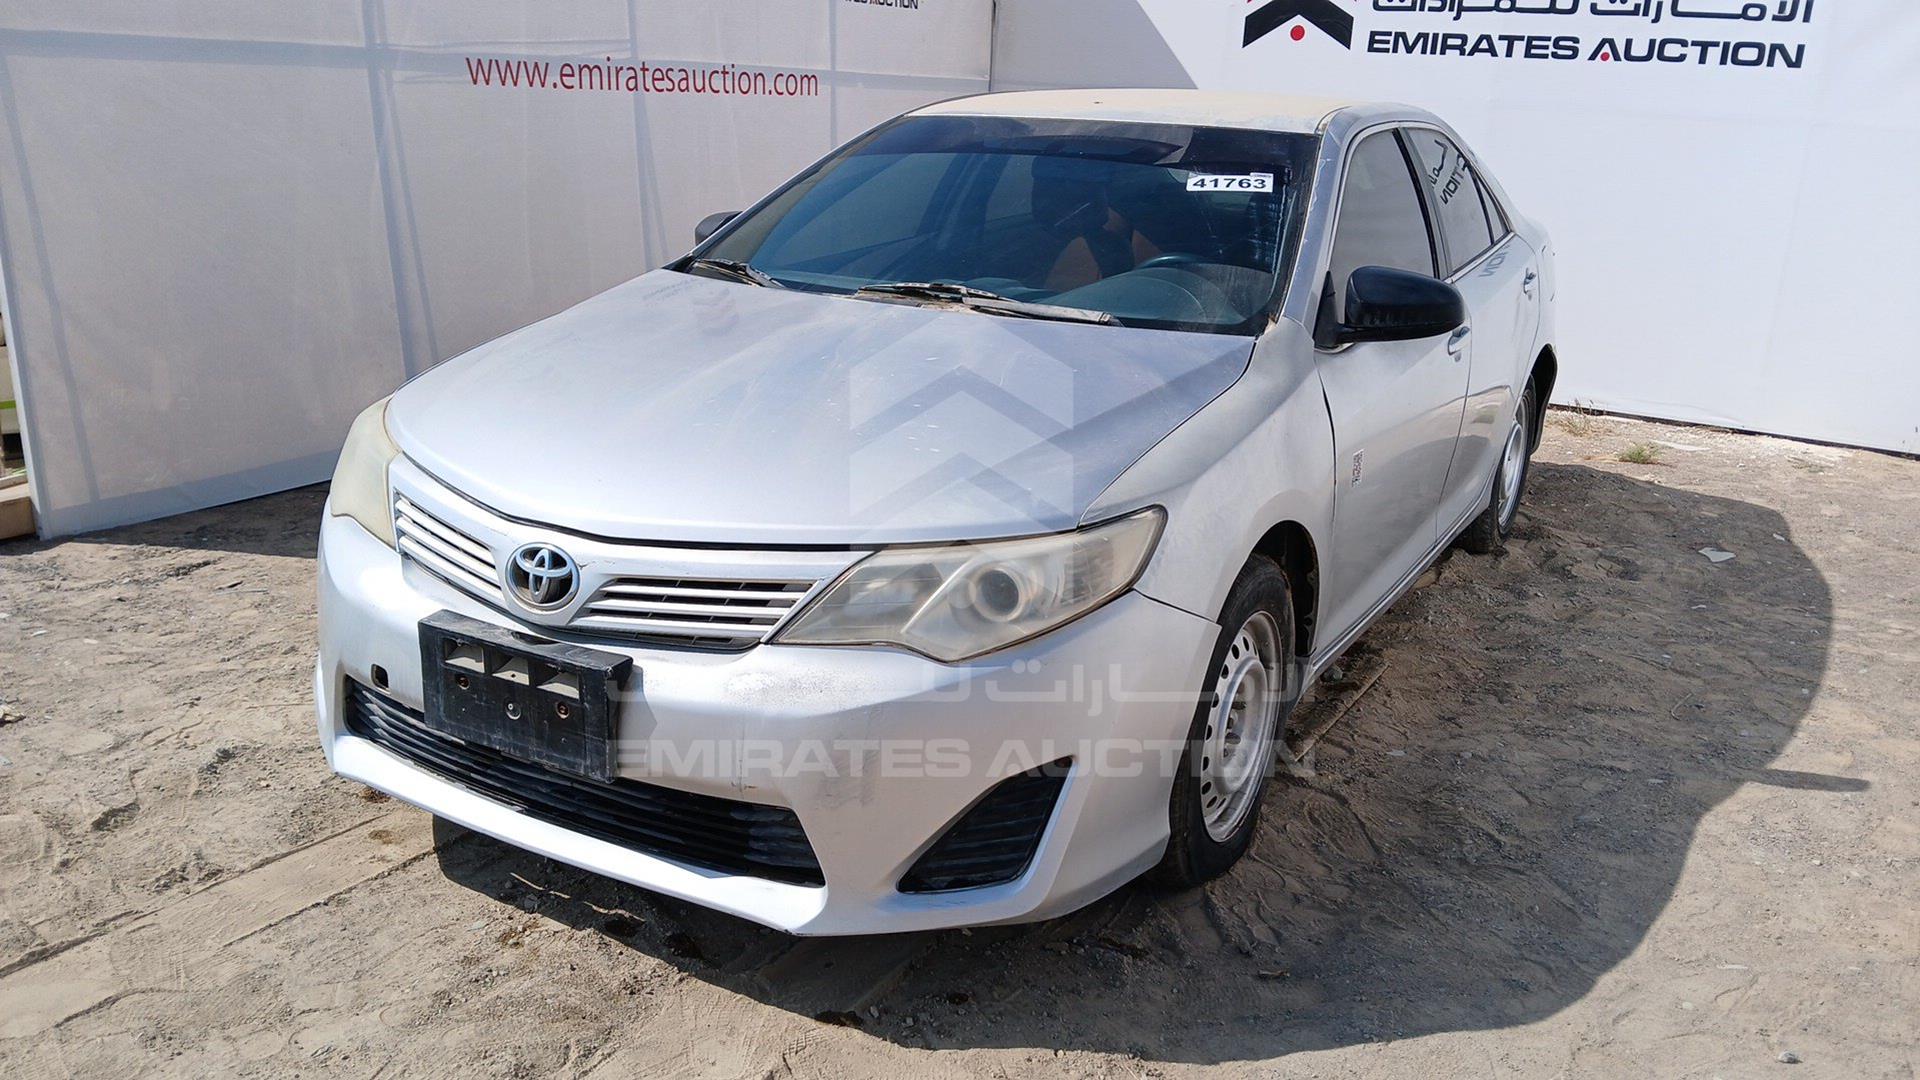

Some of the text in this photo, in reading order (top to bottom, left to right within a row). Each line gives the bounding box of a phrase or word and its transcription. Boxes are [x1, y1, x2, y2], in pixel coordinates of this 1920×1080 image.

[1366, 30, 1806, 69] EMIRATES AUCTION
[465, 55, 819, 97] www.emiratesauction.com
[1192, 178, 1267, 189] 41763
